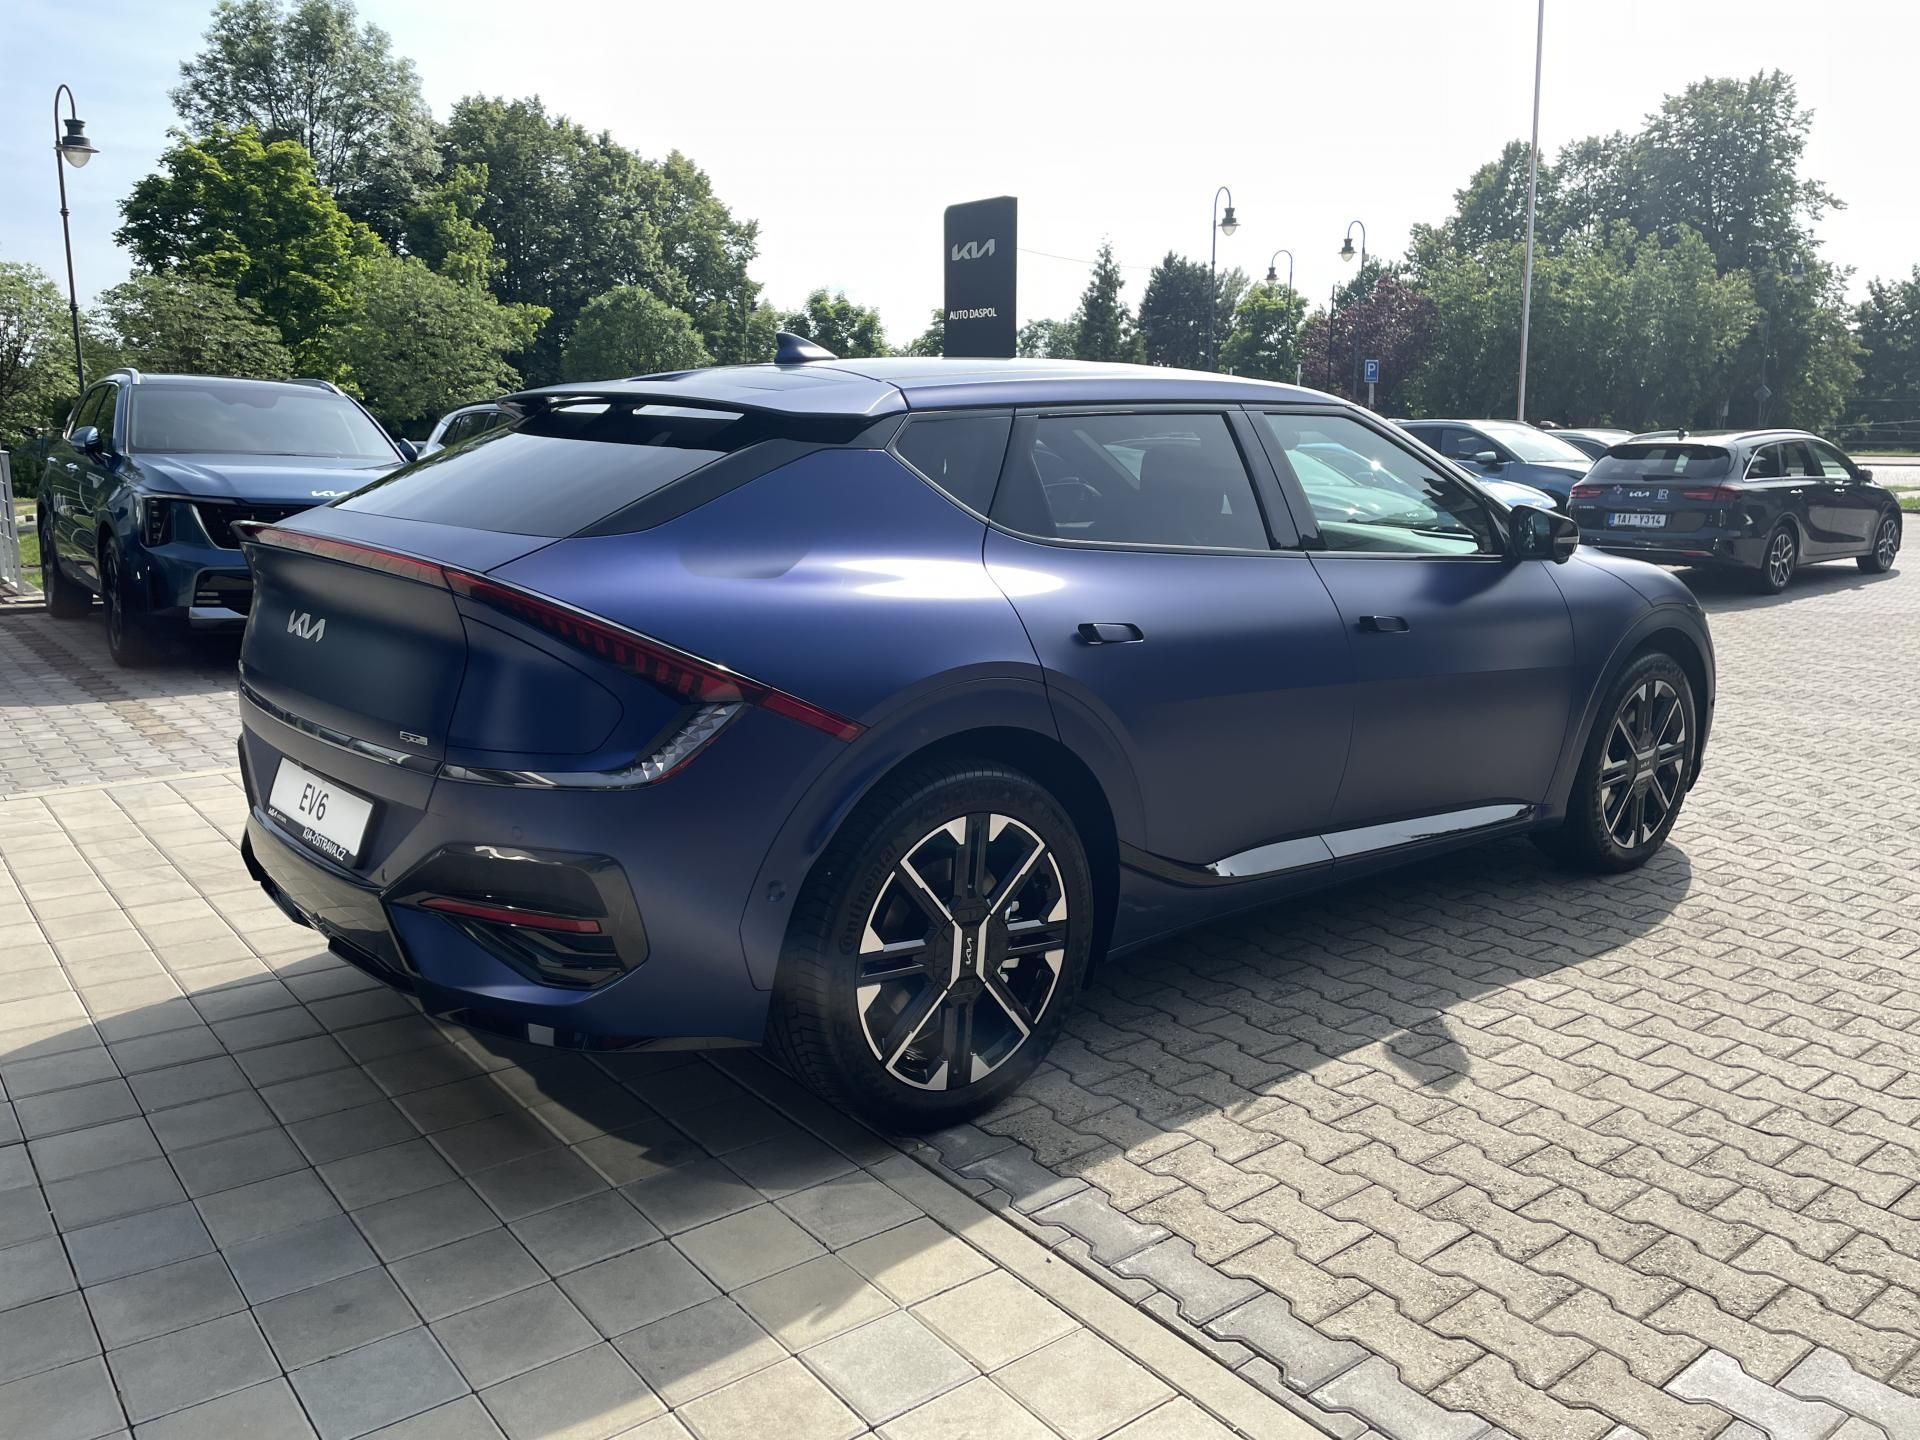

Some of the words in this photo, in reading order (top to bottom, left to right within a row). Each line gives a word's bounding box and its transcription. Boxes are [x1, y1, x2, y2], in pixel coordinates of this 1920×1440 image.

[951, 238, 996, 261] KIA
[949, 310, 968, 320] AUTO
[969, 307, 997, 319] DASPOL
[1367, 363, 1376, 376] P
[287, 609, 326, 643] KIA
[299, 782, 330, 822] EV6
[302, 826, 347, 861] KIA-OSTRAVA.CZ
